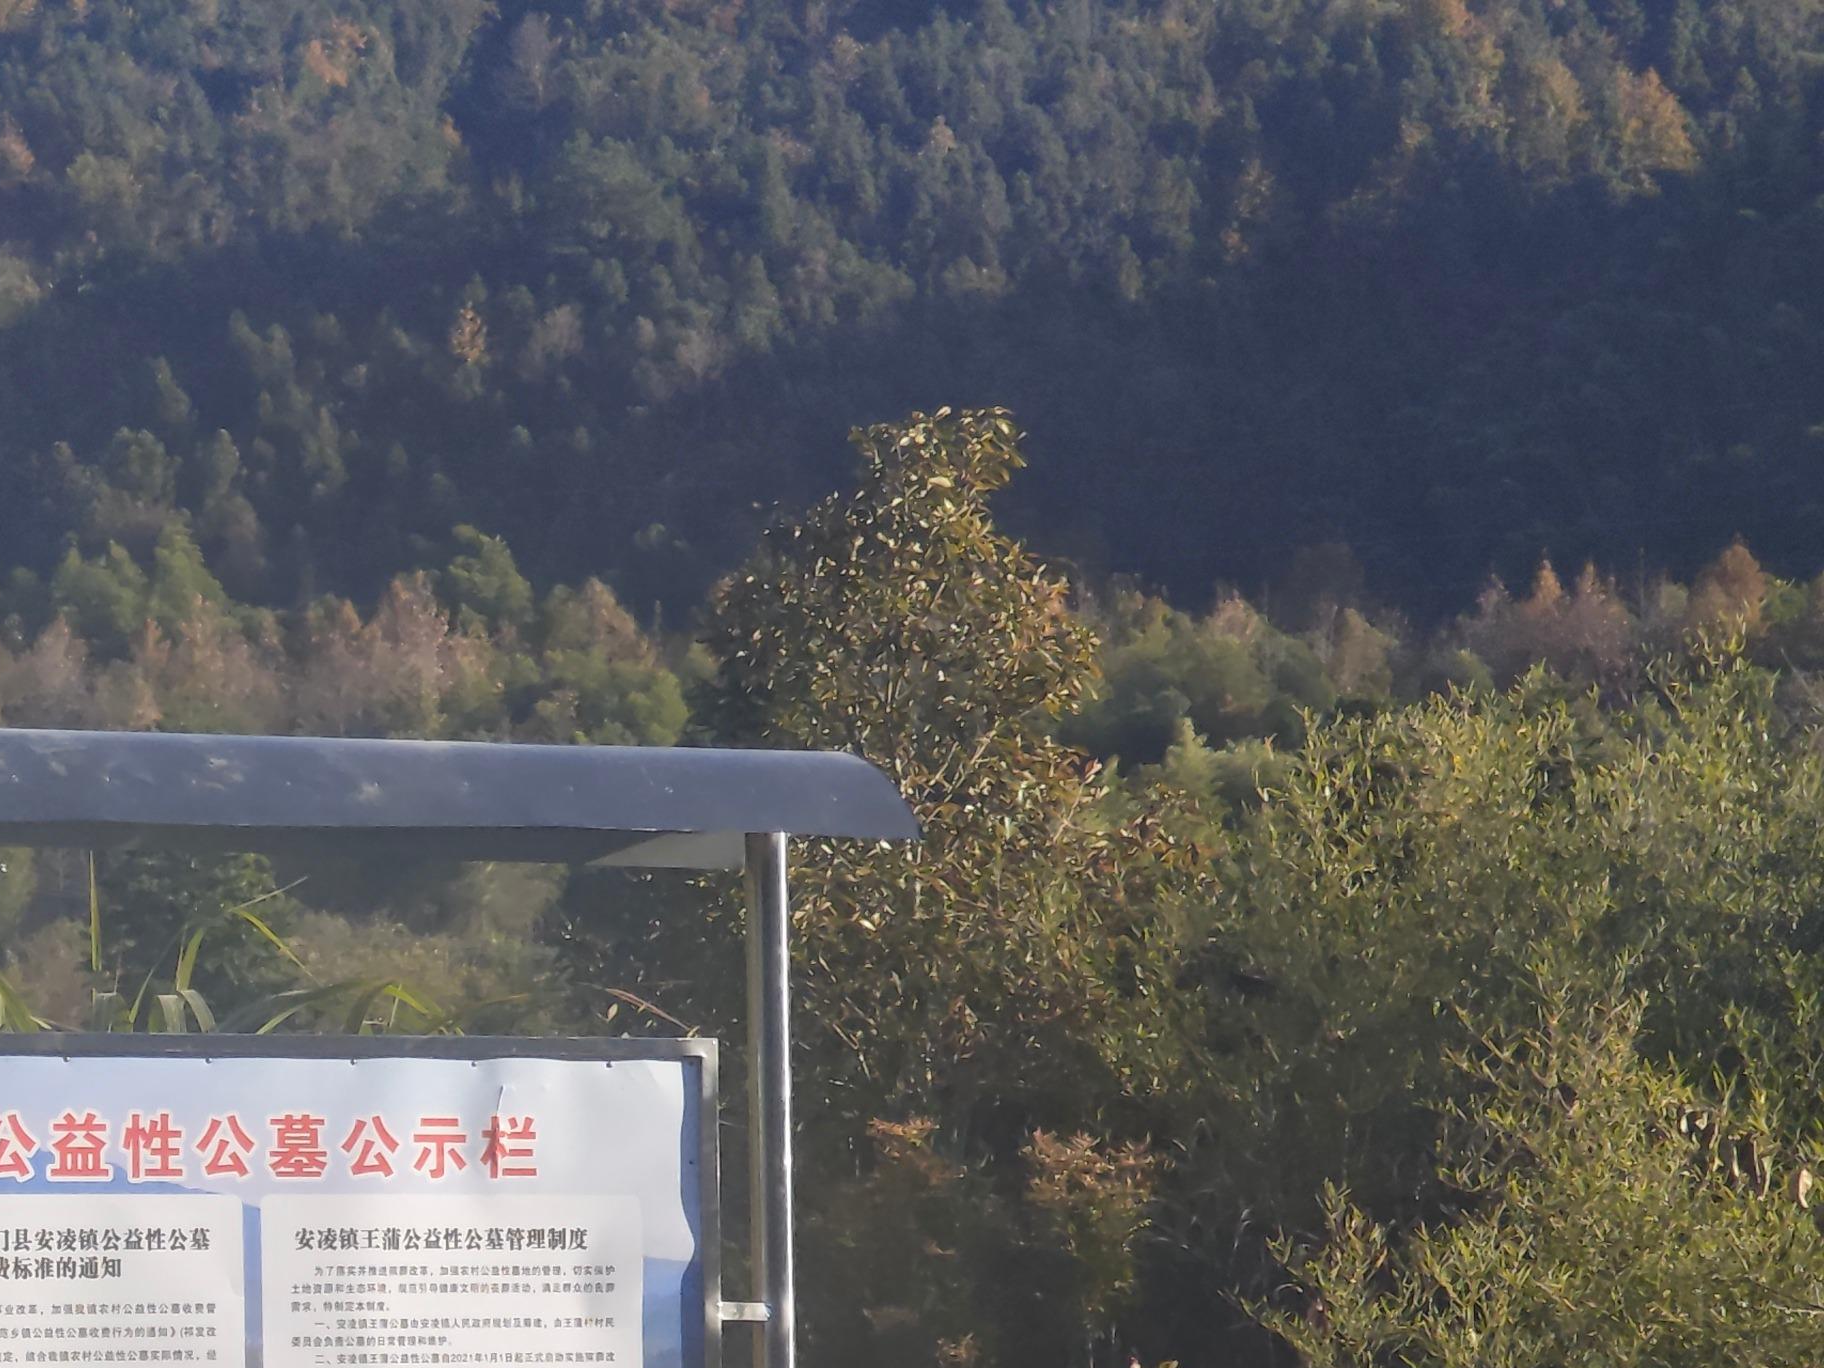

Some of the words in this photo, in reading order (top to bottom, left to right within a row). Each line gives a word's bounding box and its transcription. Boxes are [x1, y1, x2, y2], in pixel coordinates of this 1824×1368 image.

[294, 1228, 588, 1251] 安凌镇王蒲公益性公墓管理制度
